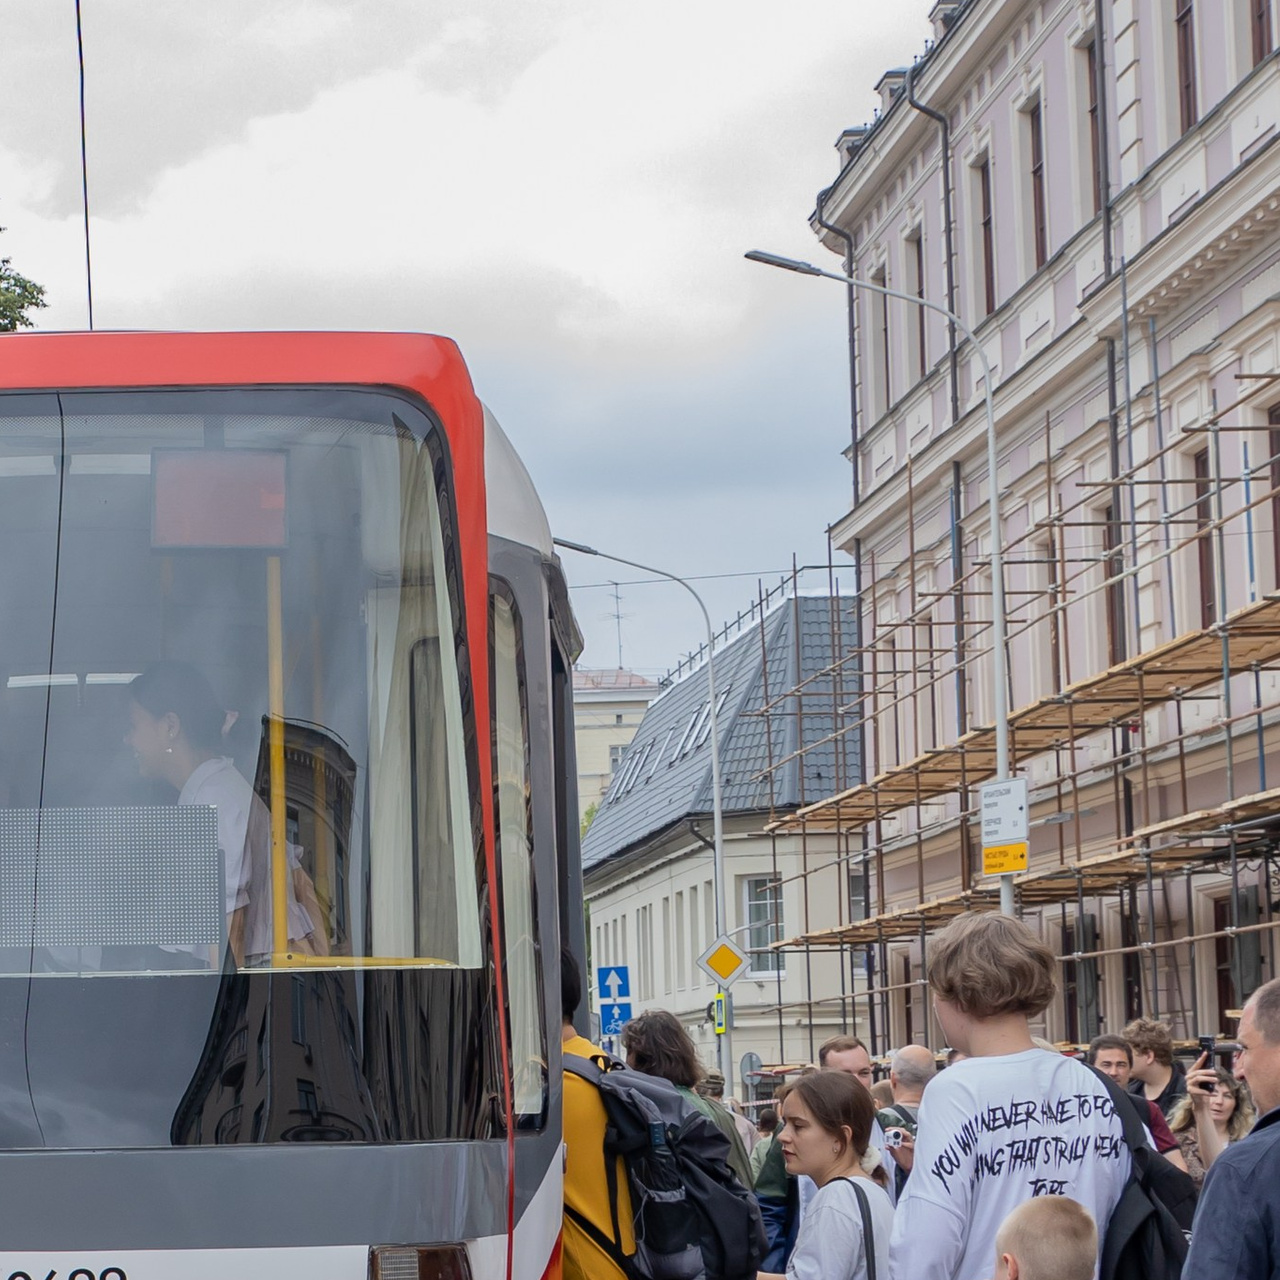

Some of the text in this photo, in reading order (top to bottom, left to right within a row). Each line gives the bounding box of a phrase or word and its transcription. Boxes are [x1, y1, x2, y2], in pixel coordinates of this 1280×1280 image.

[931, 1142, 961, 1196] YOU
[980, 1094, 1041, 1133] NEVER
[1073, 1094, 1092, 1125] TO
